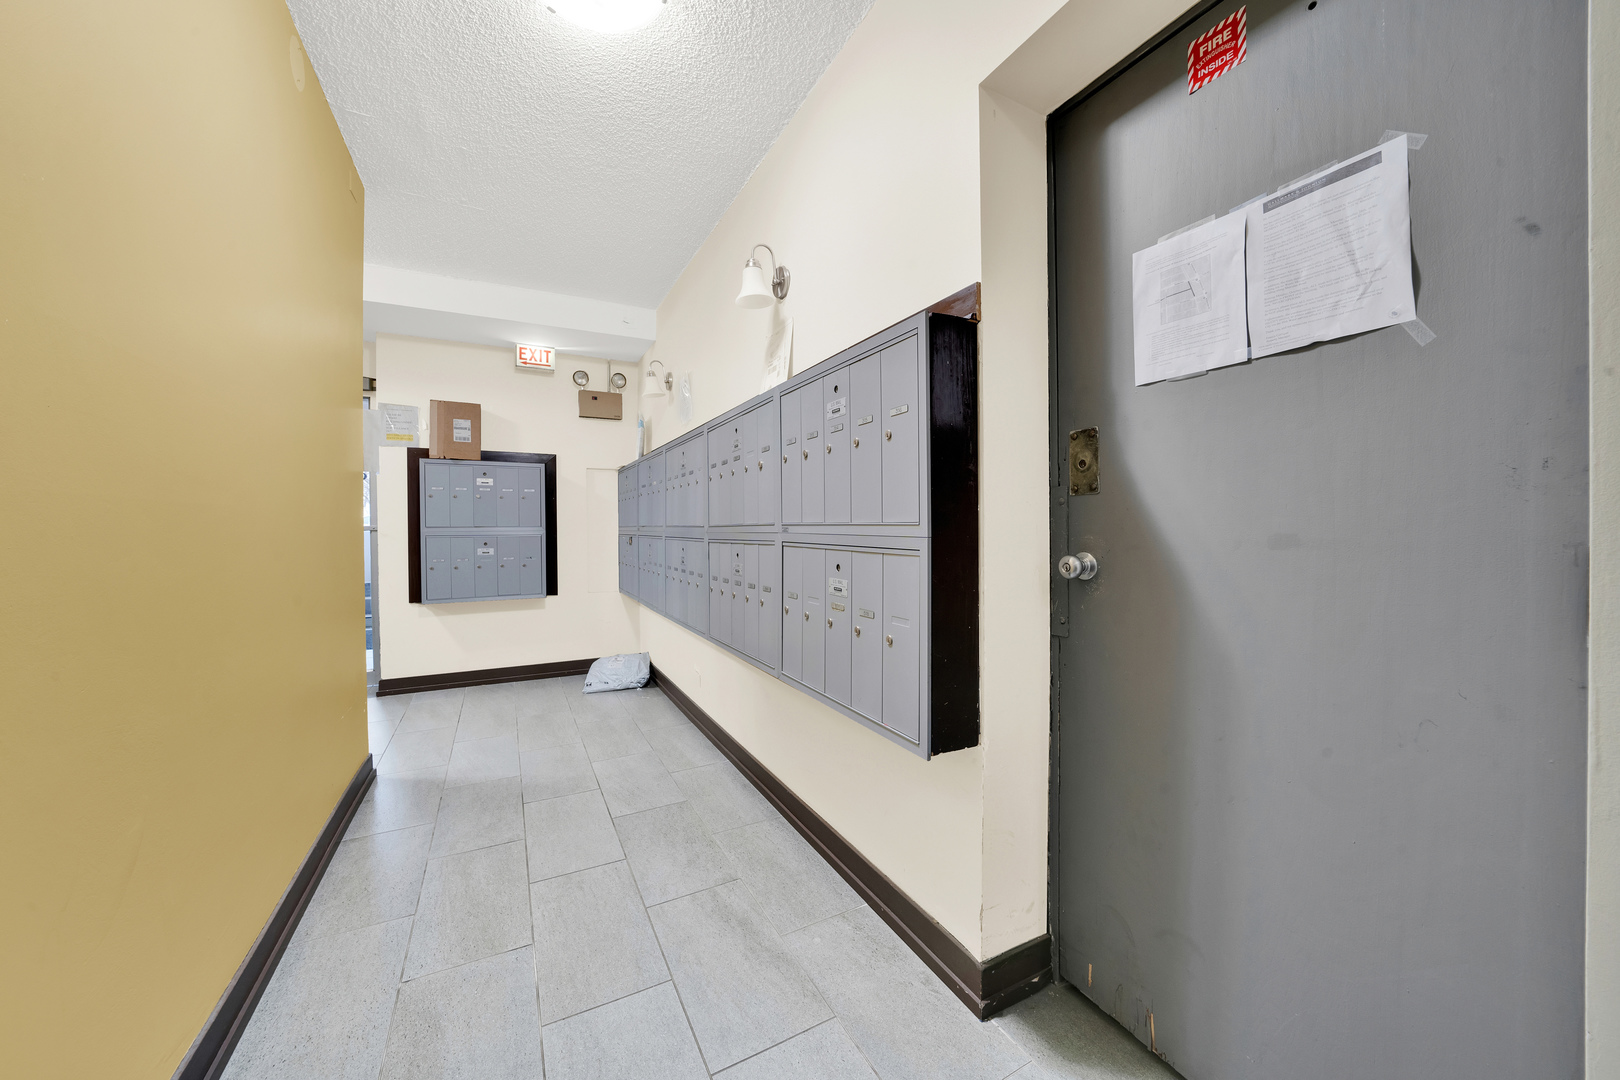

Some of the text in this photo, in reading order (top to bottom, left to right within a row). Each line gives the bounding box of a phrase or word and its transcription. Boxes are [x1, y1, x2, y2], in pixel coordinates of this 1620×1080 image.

[1195, 40, 1236, 70] EXTINGUISHER
[1199, 26, 1232, 58] FIRE
[1198, 50, 1234, 78] INSIDE
[519, 347, 551, 363] EXIT
